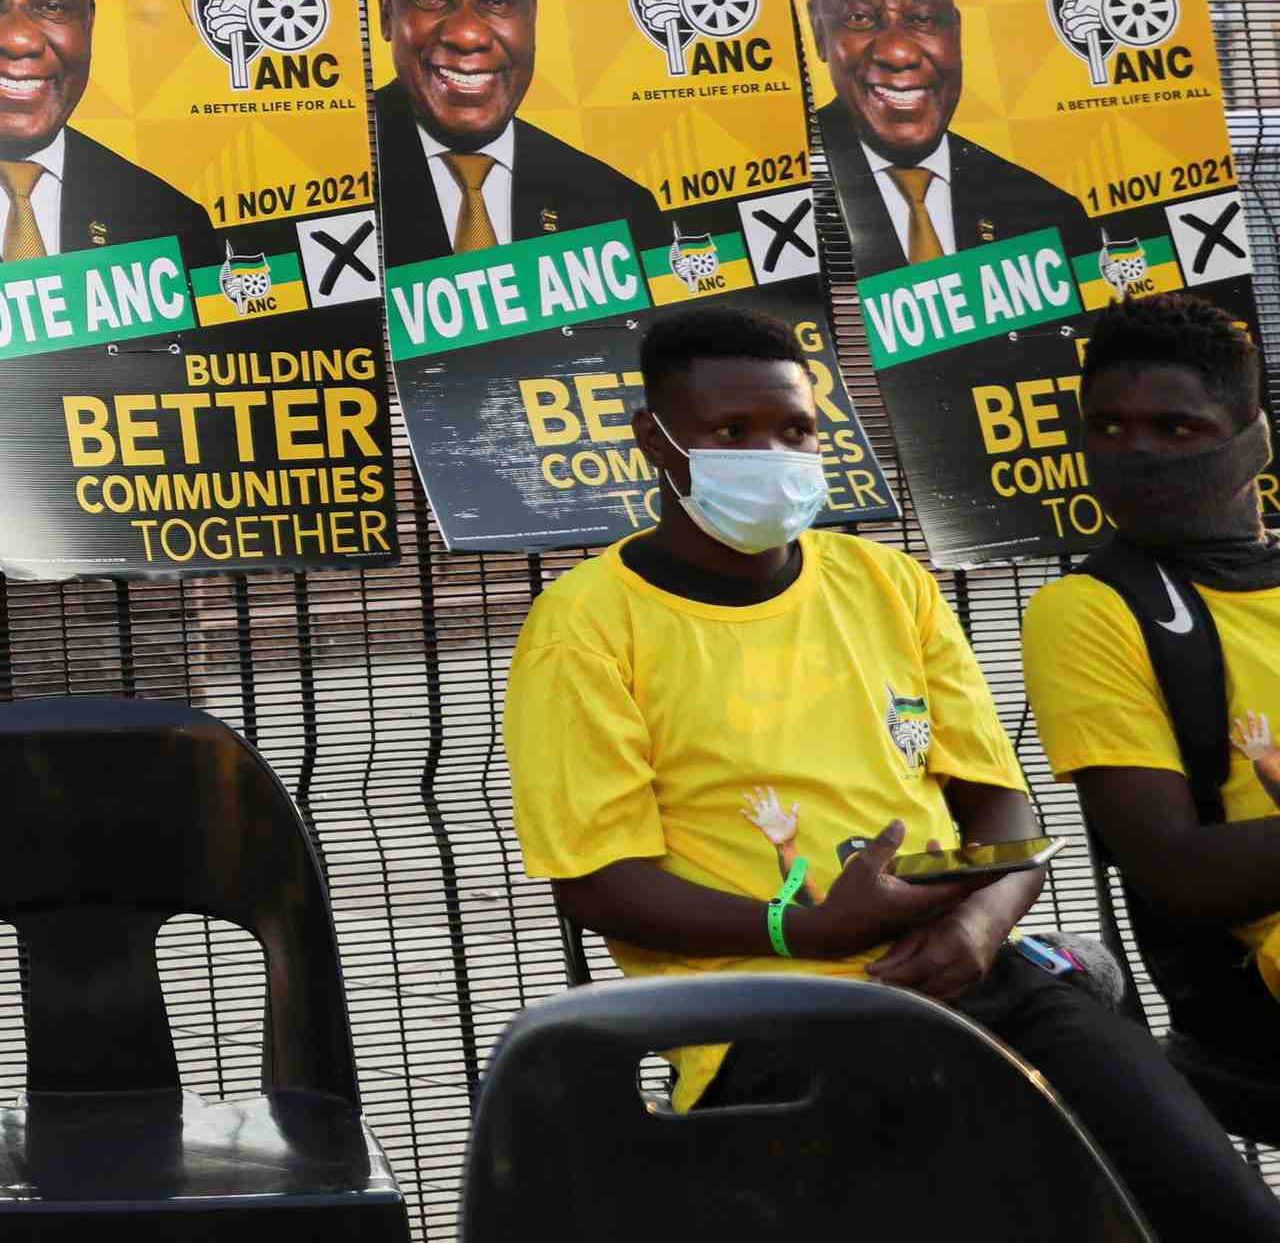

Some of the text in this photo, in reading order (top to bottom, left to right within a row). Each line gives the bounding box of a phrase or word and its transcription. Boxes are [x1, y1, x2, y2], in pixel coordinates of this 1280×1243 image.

[255, 53, 340, 90] ANC
[692, 38, 773, 76] ANC
[1114, 46, 1194, 84] ANC
[191, 99, 355, 114] A BETTER LIFE FOR ALL
[632, 81, 790, 101] A BETTER LIFE FOR ALL
[1057, 88, 1212, 112] A BETTER LIFE FOR ALL
[214, 172, 370, 222] 1 NOV 2021
[659, 151, 807, 204] 1 NOV 2021
[1088, 156, 1233, 211] 1 NOV 2021
[86, 257, 184, 333] ANC
[392, 241, 637, 345] VOTE ANC
[697, 276, 725, 292] ANC
[864, 274, 976, 354] VOTE
[983, 248, 1070, 324] ANC
[1127, 279, 1154, 294] ANC
[247, 297, 277, 314] ANC
[185, 348, 376, 387] BUILDING
[62, 387, 383, 467] BETTER
[76, 465, 385, 514] COMMUNITIES
[131, 511, 391, 562] TOGETHER
